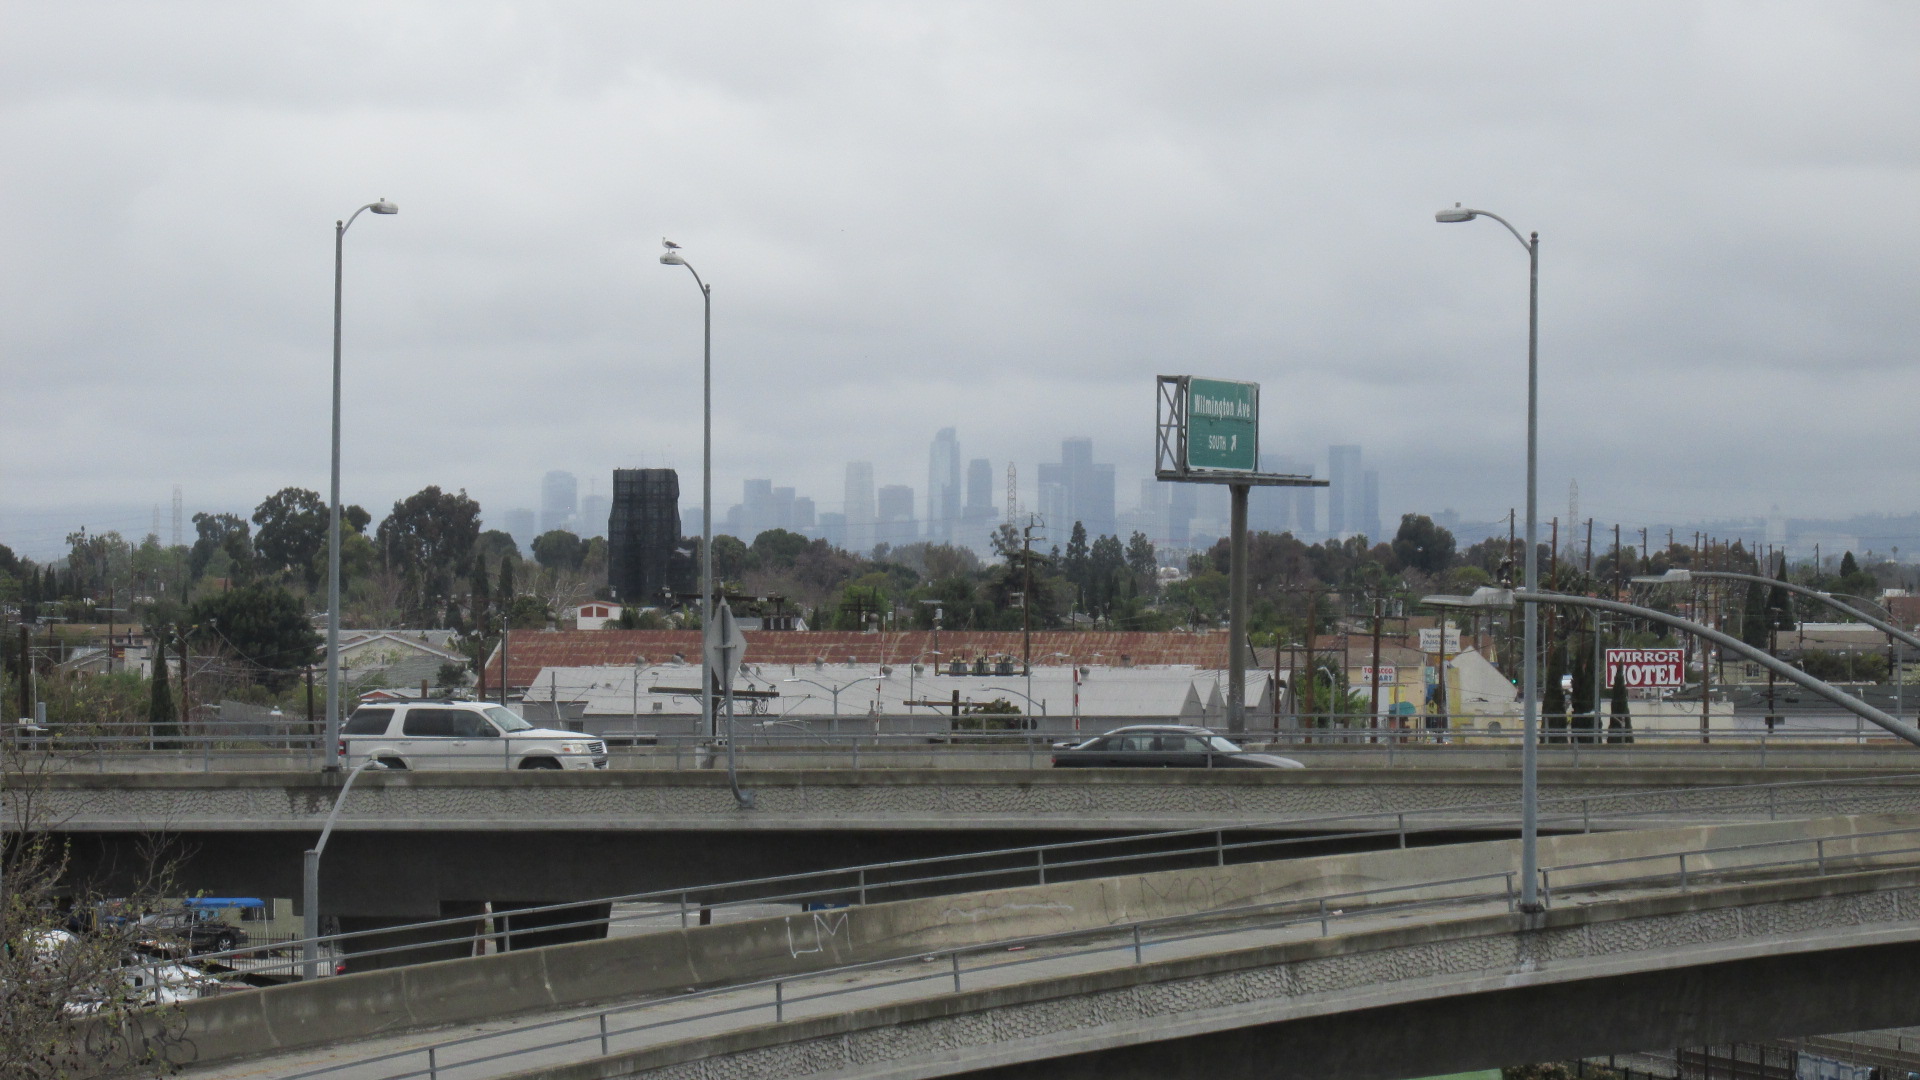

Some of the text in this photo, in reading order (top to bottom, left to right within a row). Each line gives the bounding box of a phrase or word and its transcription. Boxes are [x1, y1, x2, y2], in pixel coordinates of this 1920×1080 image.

[1194, 394, 1251, 420] Wilmington Ave
[1208, 434, 1227, 451] SOUTH
[1609, 651, 1680, 663] MIRROR
